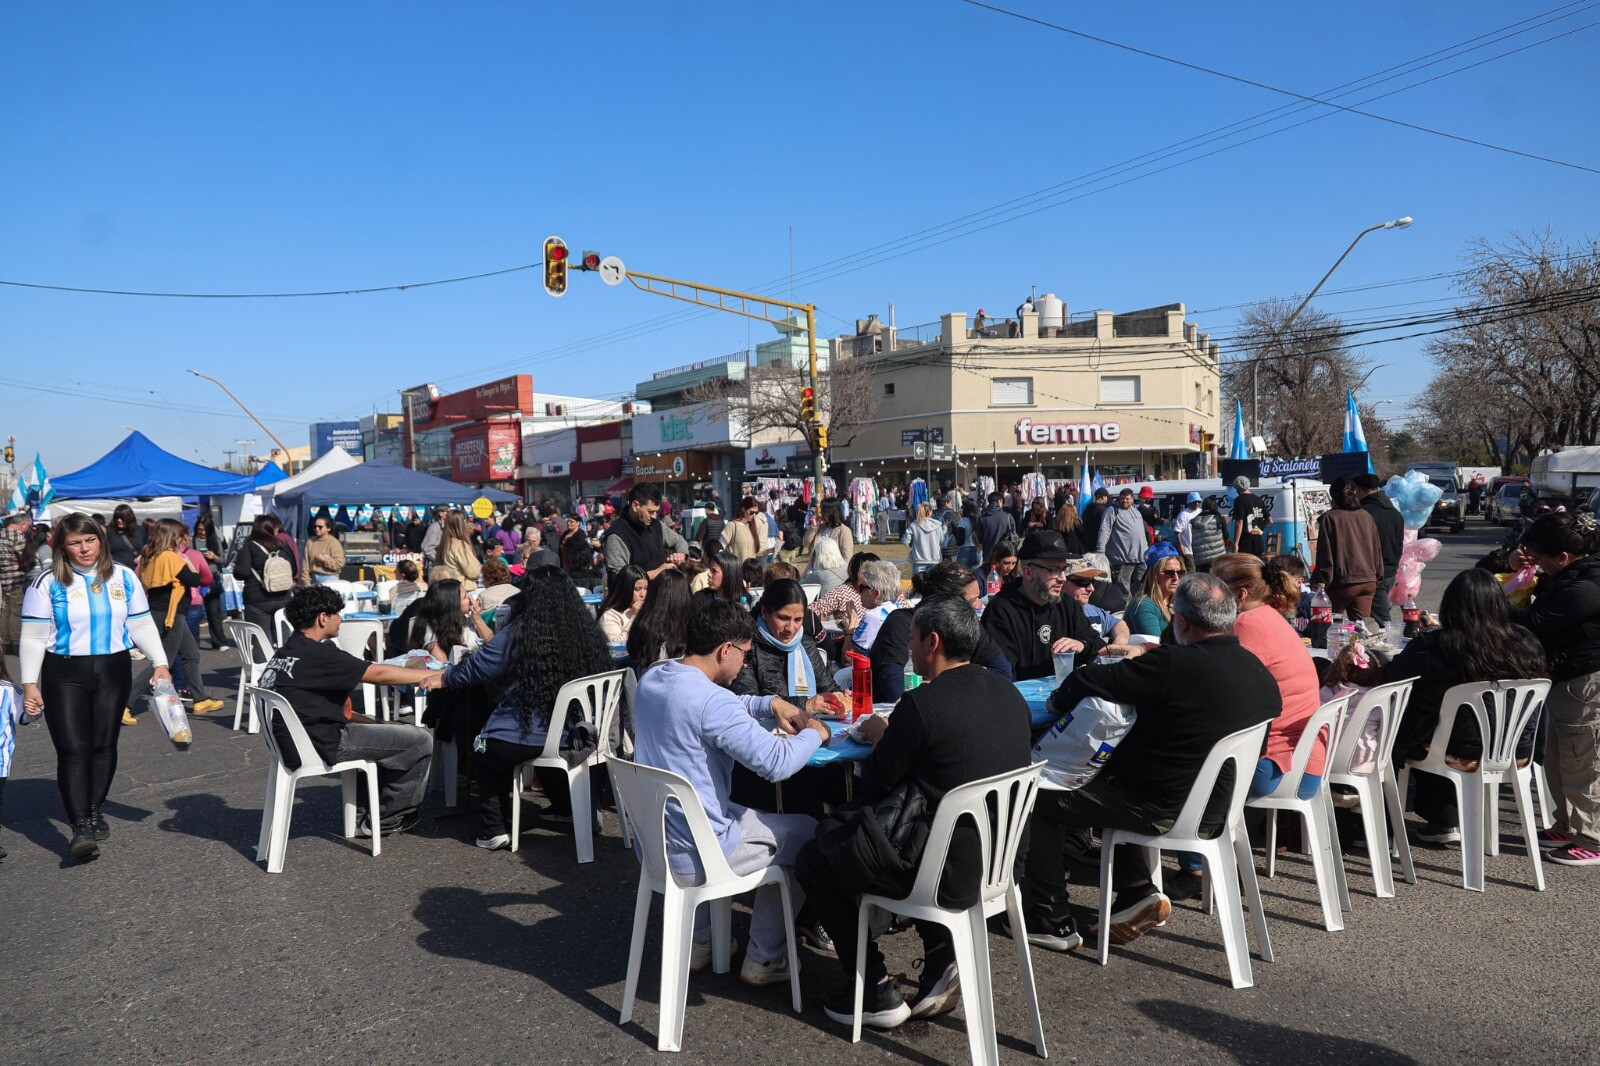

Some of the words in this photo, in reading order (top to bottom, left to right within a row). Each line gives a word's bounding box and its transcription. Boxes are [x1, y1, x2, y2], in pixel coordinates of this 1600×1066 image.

[1016, 418, 1121, 443] femme
[459, 453, 481, 469] PIZZICO
[1260, 460, 1270, 475] La
[1272, 459, 1320, 472] Scaloneta
